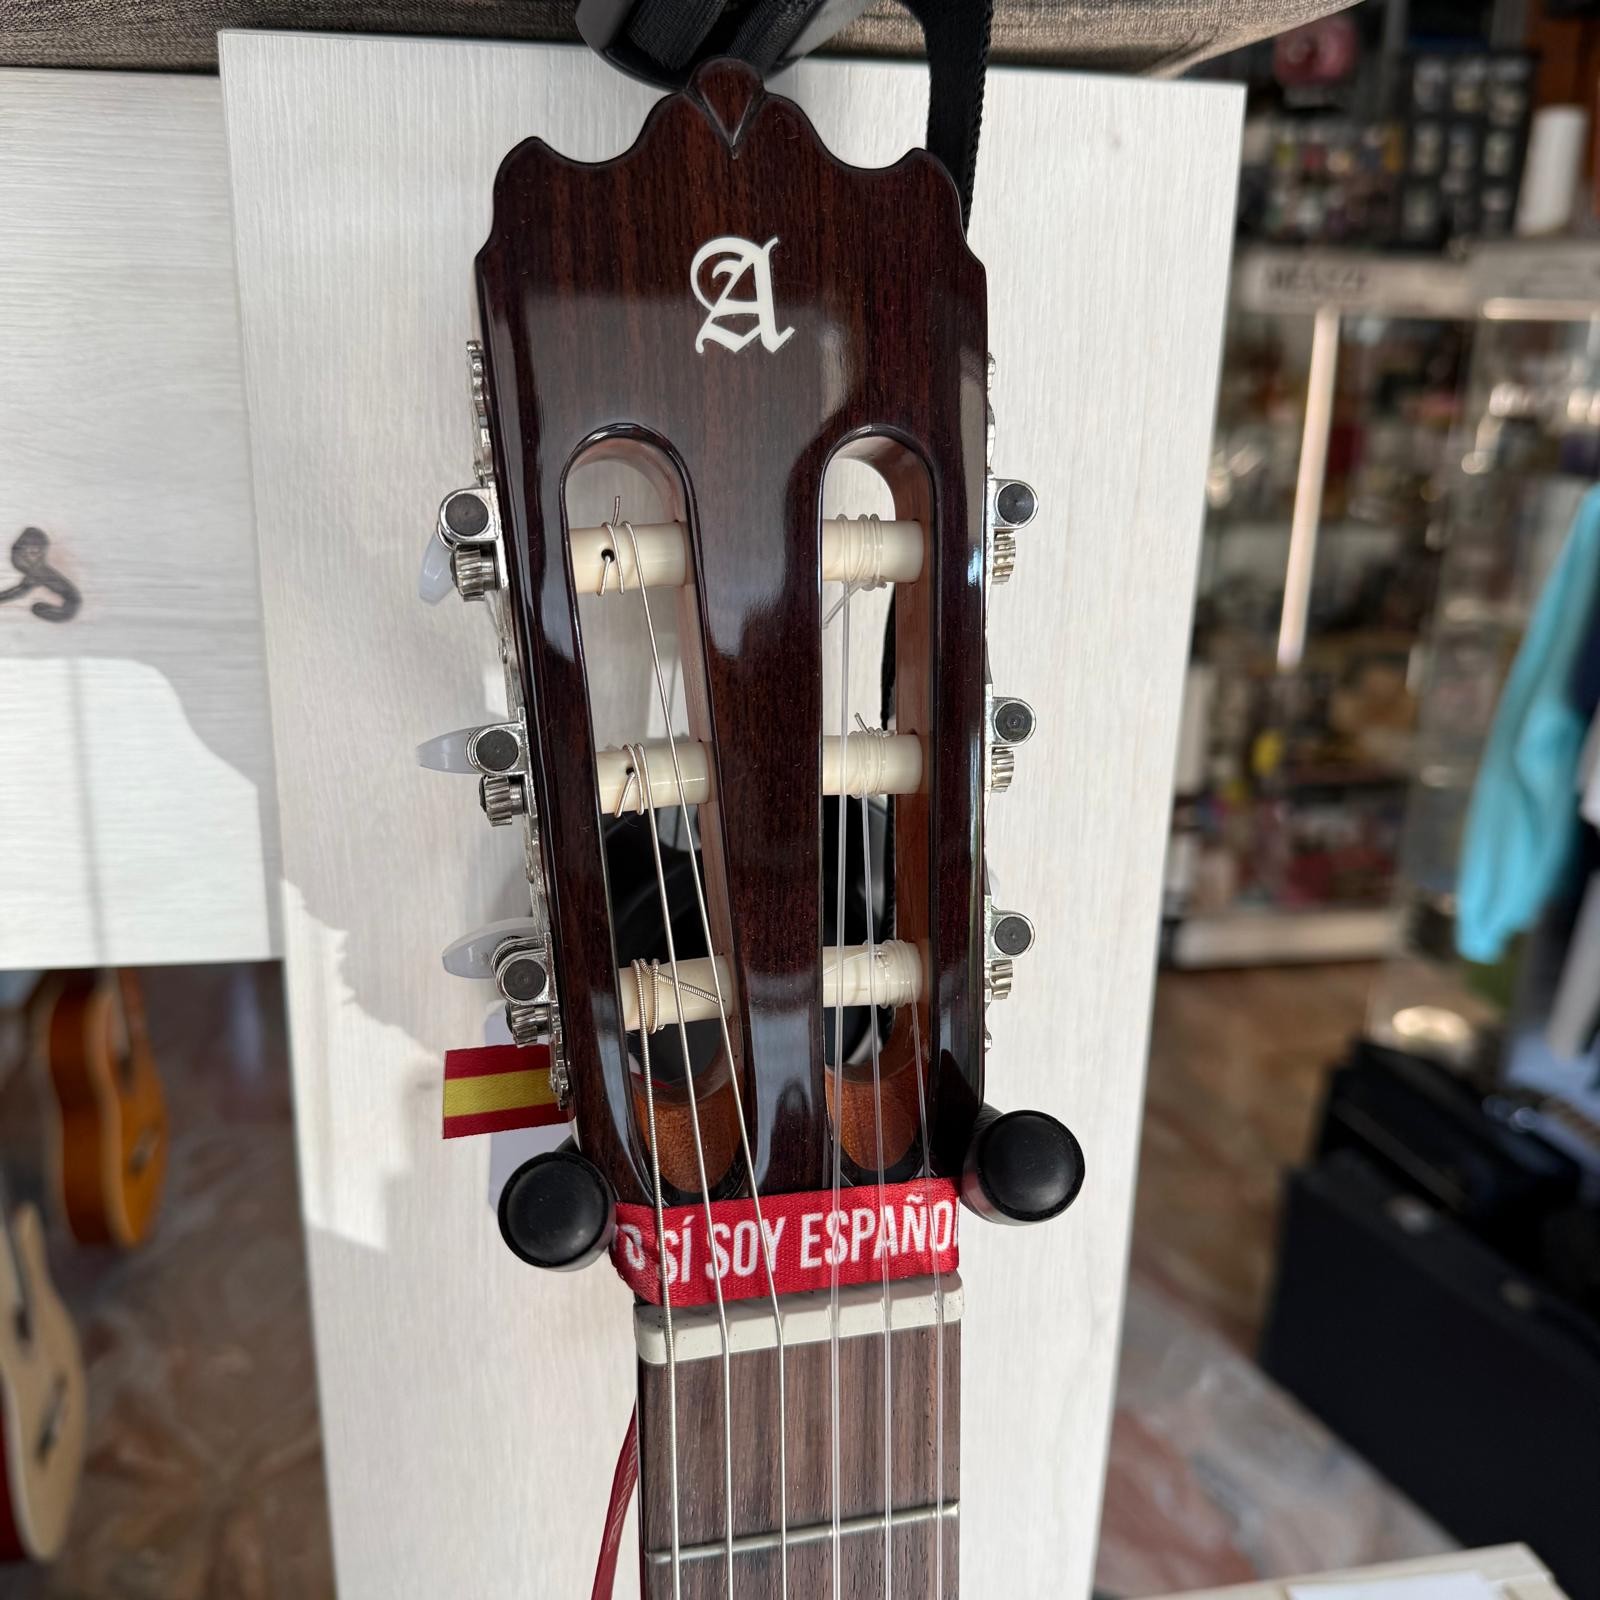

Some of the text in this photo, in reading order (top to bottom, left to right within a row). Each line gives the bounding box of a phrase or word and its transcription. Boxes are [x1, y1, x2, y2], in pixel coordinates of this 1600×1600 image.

[690, 236, 795, 353] A
[657, 1215, 696, 1286] SÍ
[705, 1216, 786, 1281] SOY
